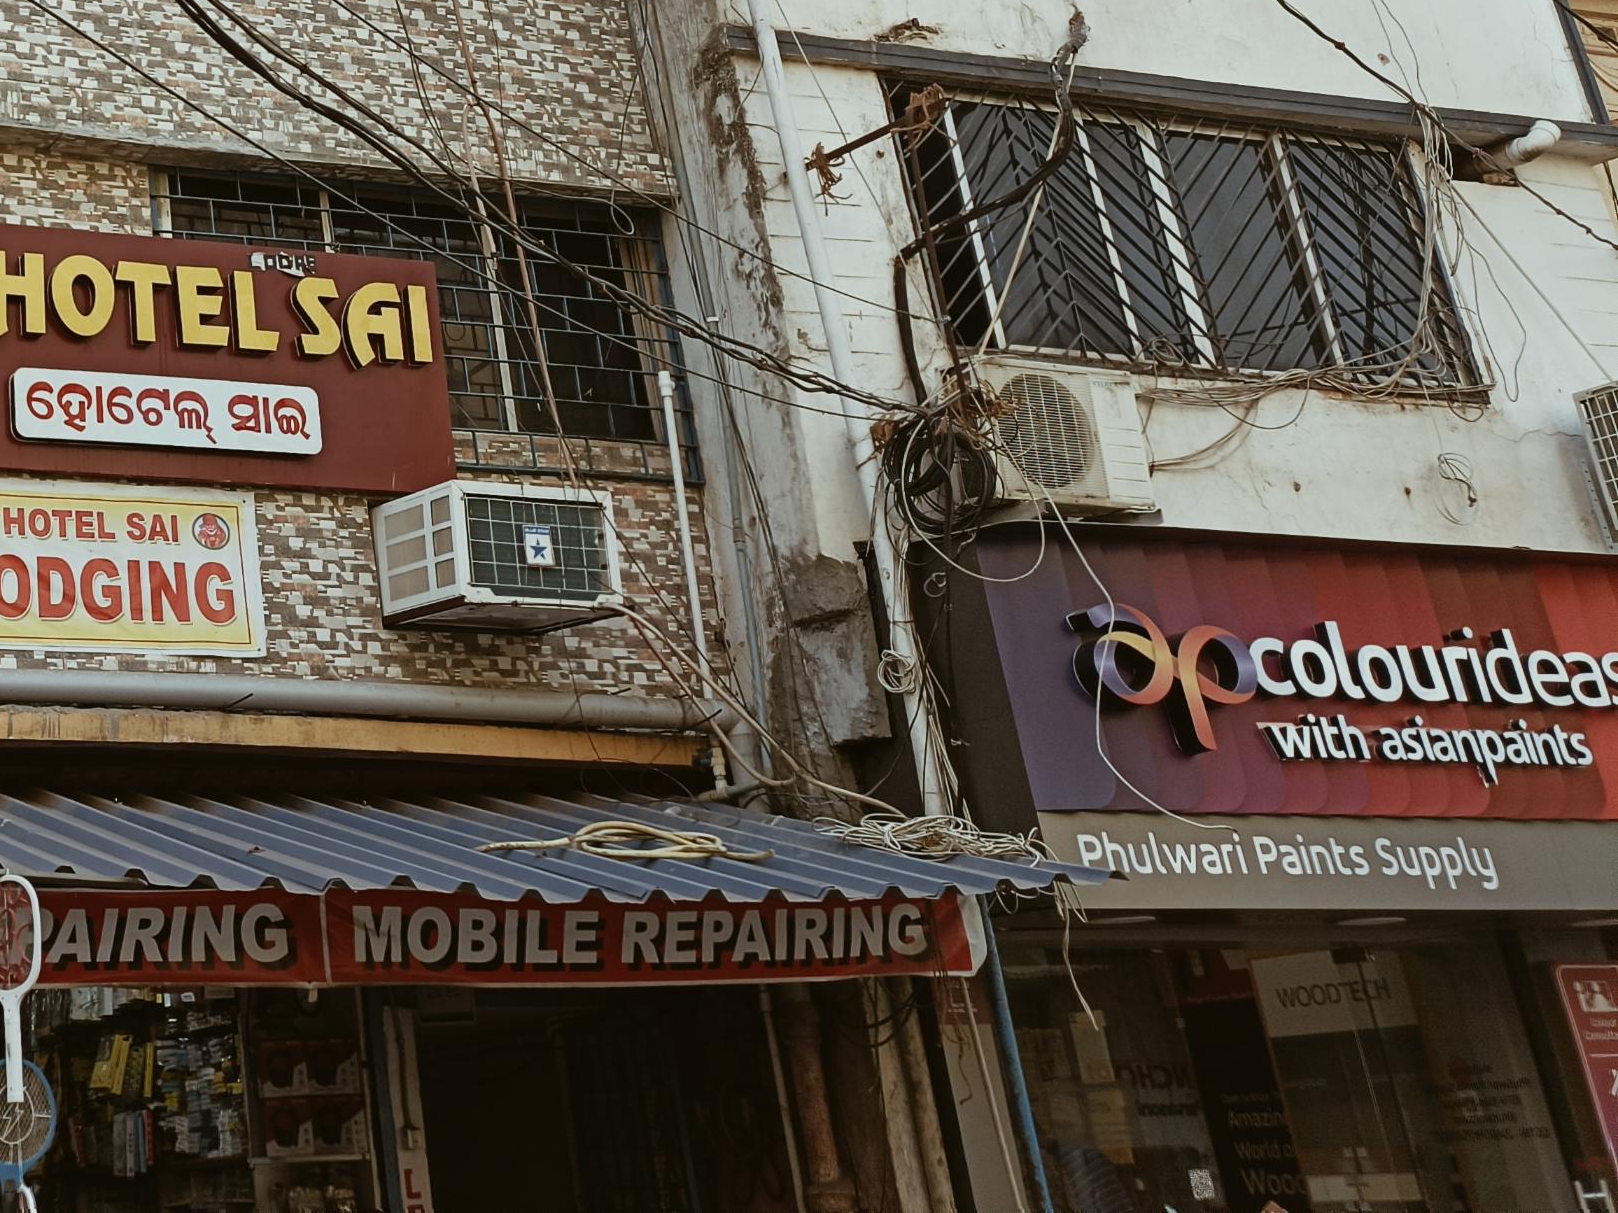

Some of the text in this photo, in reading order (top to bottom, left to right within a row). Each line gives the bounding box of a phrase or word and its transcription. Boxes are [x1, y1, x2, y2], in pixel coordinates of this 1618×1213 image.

[293, 276, 435, 370] SAI
[26, 380, 311, 445] ହୋଟେଲ୍ ସାଇ
[2, 507, 180, 547] HOTEL SAI
[1270, 713, 1594, 786] with asianpaints
[1076, 831, 1500, 890] Phulwari Paints Supply
[352, 902, 928, 966] MOBILE REPAIRING
